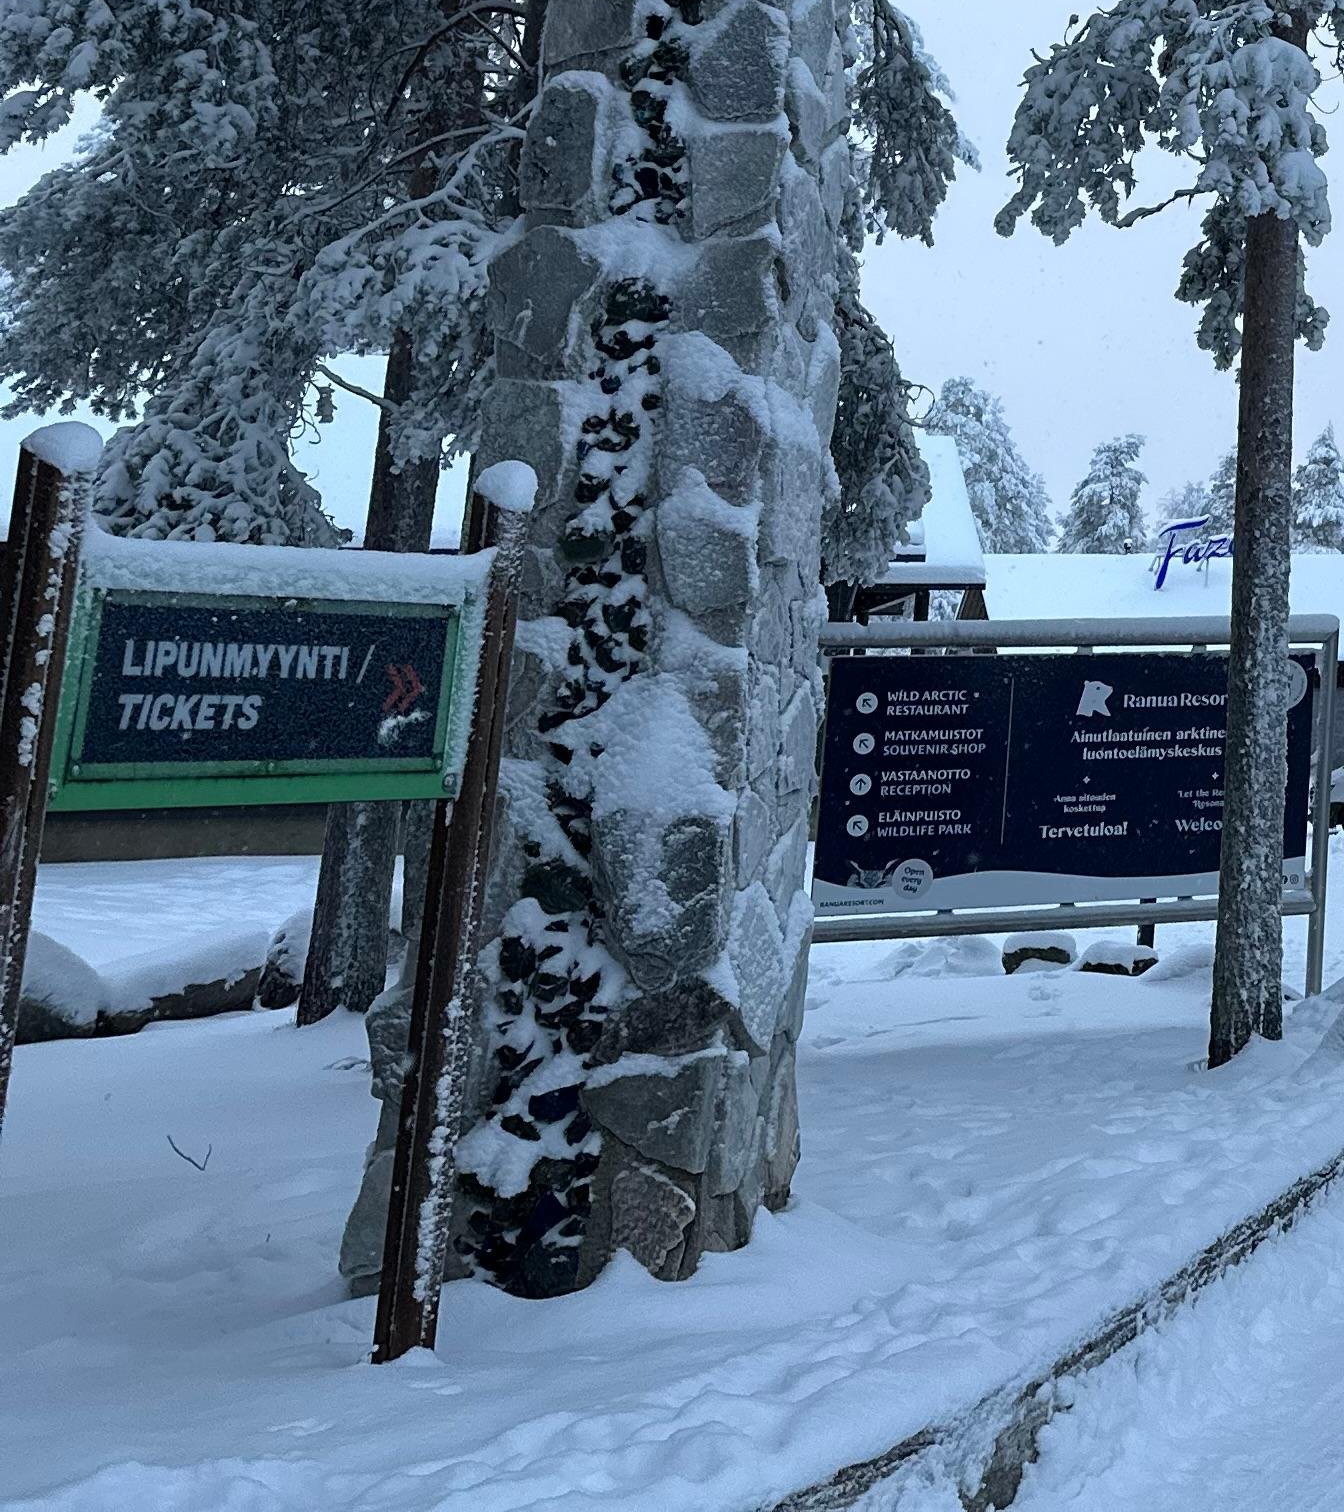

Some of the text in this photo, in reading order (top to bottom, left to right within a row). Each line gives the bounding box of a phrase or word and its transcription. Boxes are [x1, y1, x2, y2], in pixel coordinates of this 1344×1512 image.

[122, 639, 376, 684] LIPUNMYYNTI /
[887, 690, 968, 702] WILD ARCTIC
[1123, 692, 1228, 708] Ranua Resor
[118, 694, 262, 730] TICKETS
[887, 704, 969, 716] RESTAURANT
[885, 729, 984, 742] MATKAMUISTOT
[1070, 726, 1227, 743] Ainutlaatuinen arktine
[883, 743, 986, 756] SOUVENIR SHOP
[1082, 743, 1222, 760] luontoelämyskeskus
[881, 769, 971, 782] VASTAANOTTO
[880, 783, 952, 797] RECEPTION
[1212, 788, 1225, 797] Re
[879, 808, 961, 822] ELÄINPUISTO
[877, 823, 972, 837] WILDLIFE PARK
[1040, 821, 1128, 839] Tervetuloa!
[1175, 817, 1223, 832] Welco
